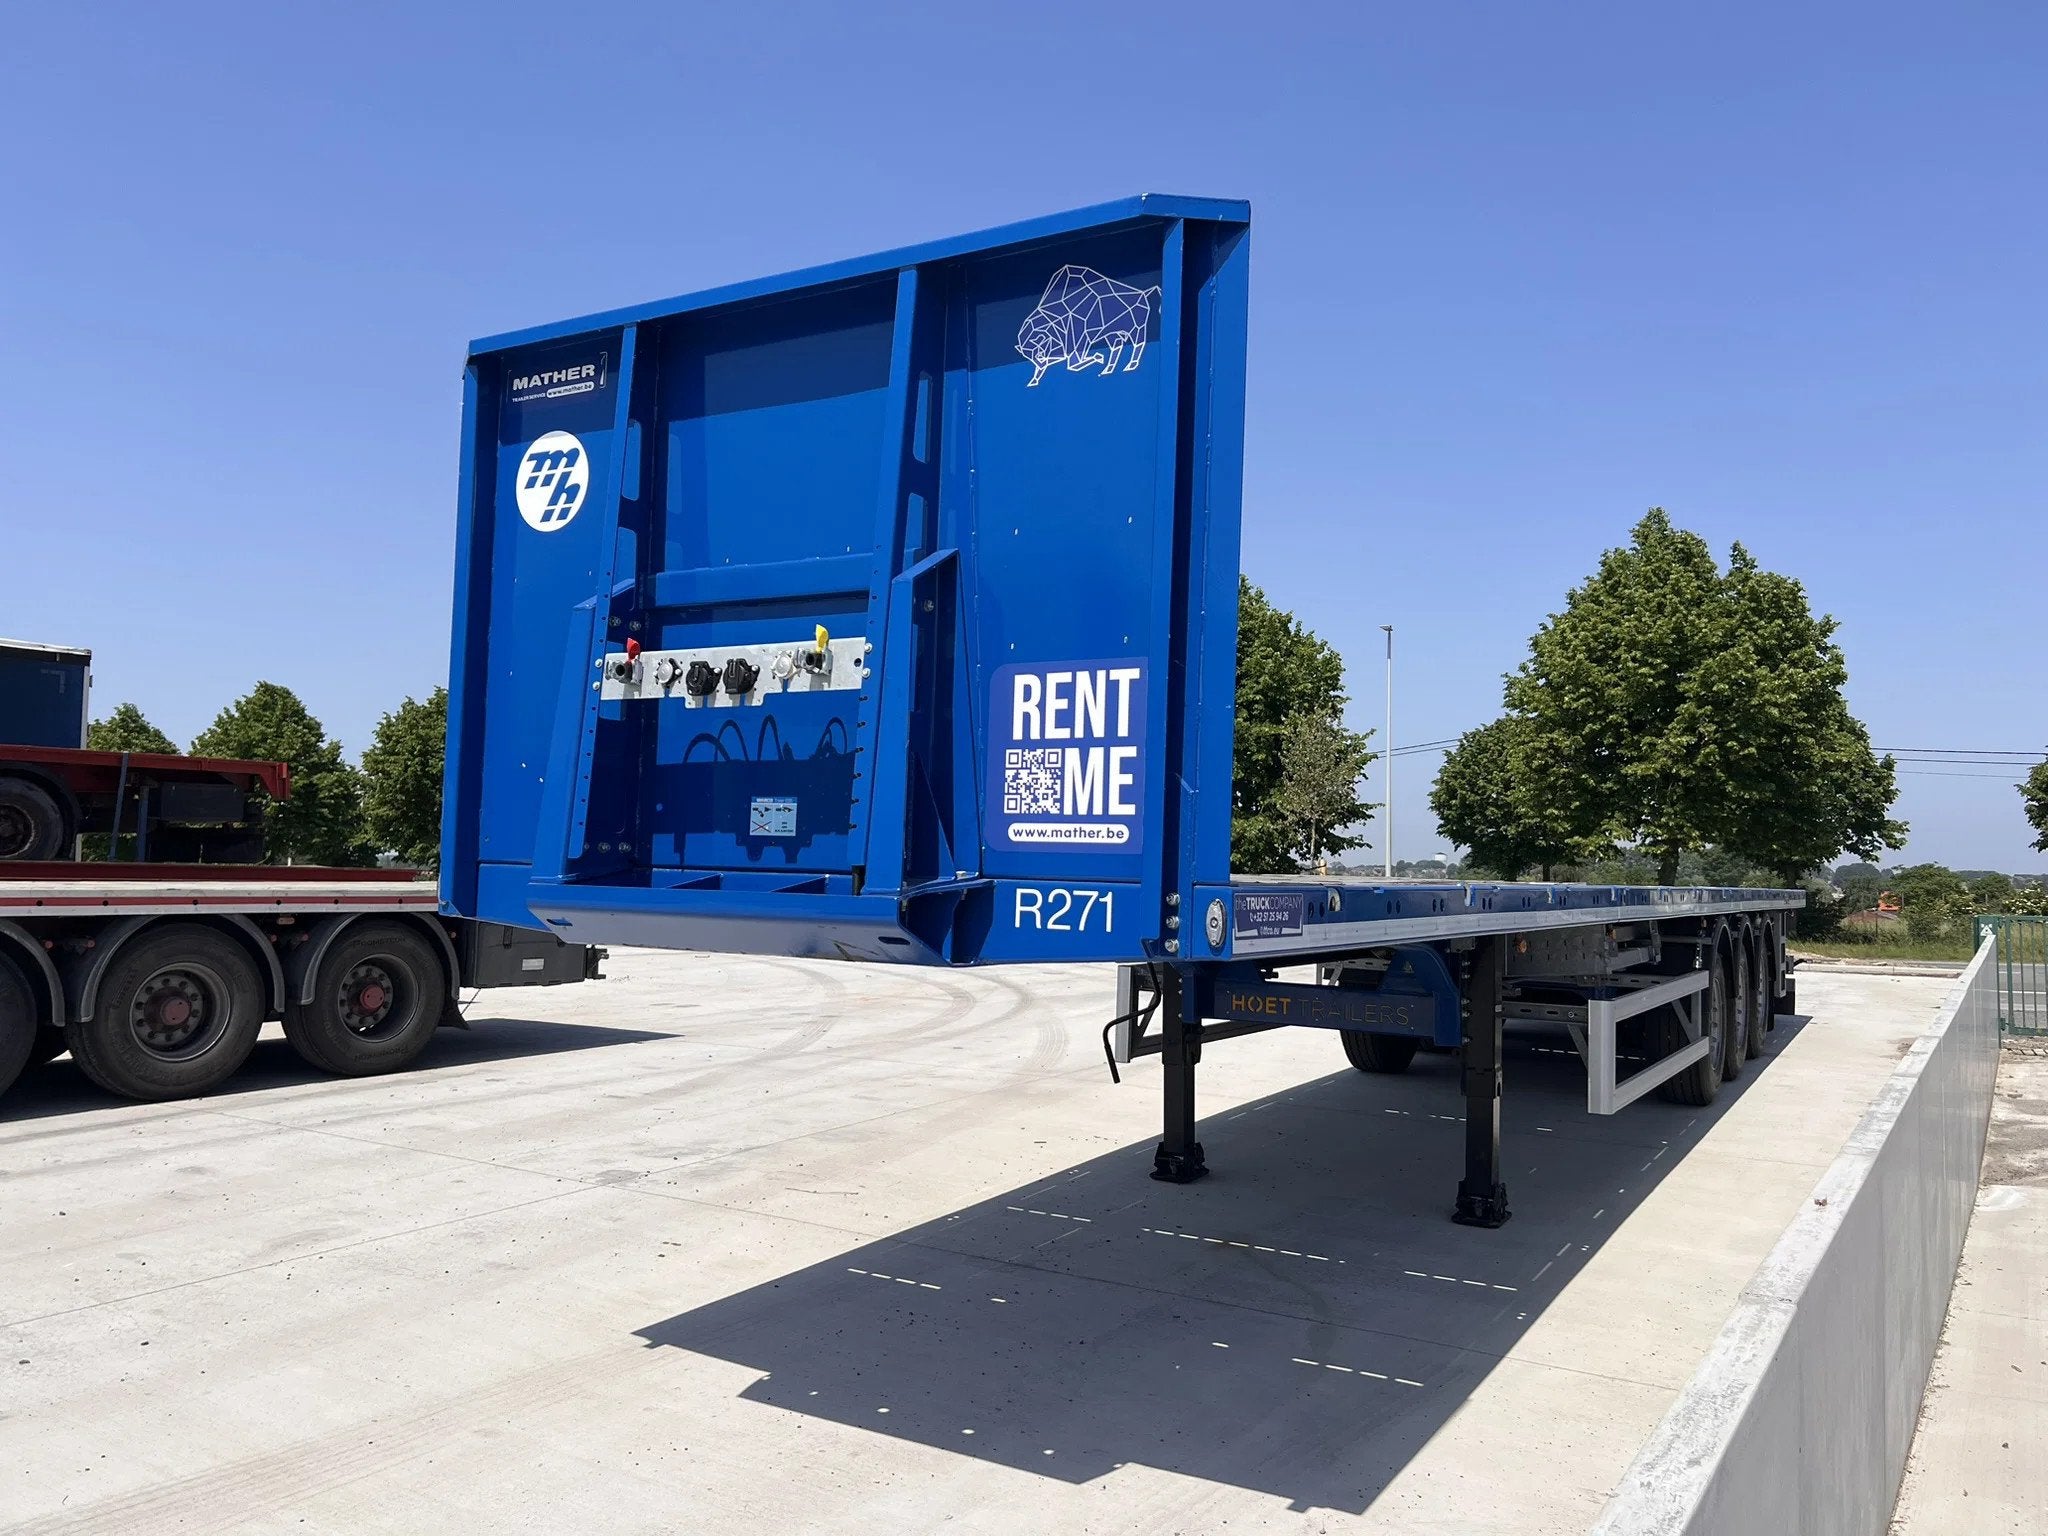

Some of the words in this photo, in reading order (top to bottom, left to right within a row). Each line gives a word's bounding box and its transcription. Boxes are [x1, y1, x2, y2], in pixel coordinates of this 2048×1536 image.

[512, 364, 595, 391] MATHER
[547, 382, 592, 396] www.mather.be
[1012, 667, 1141, 741] RENT
[1063, 746, 1137, 816] ME
[1012, 826, 1125, 840] www.mather.be
[1014, 887, 1113, 933] R271
[1231, 994, 1292, 1015] HOET
[1299, 1000, 1409, 1026] TRAILERS
